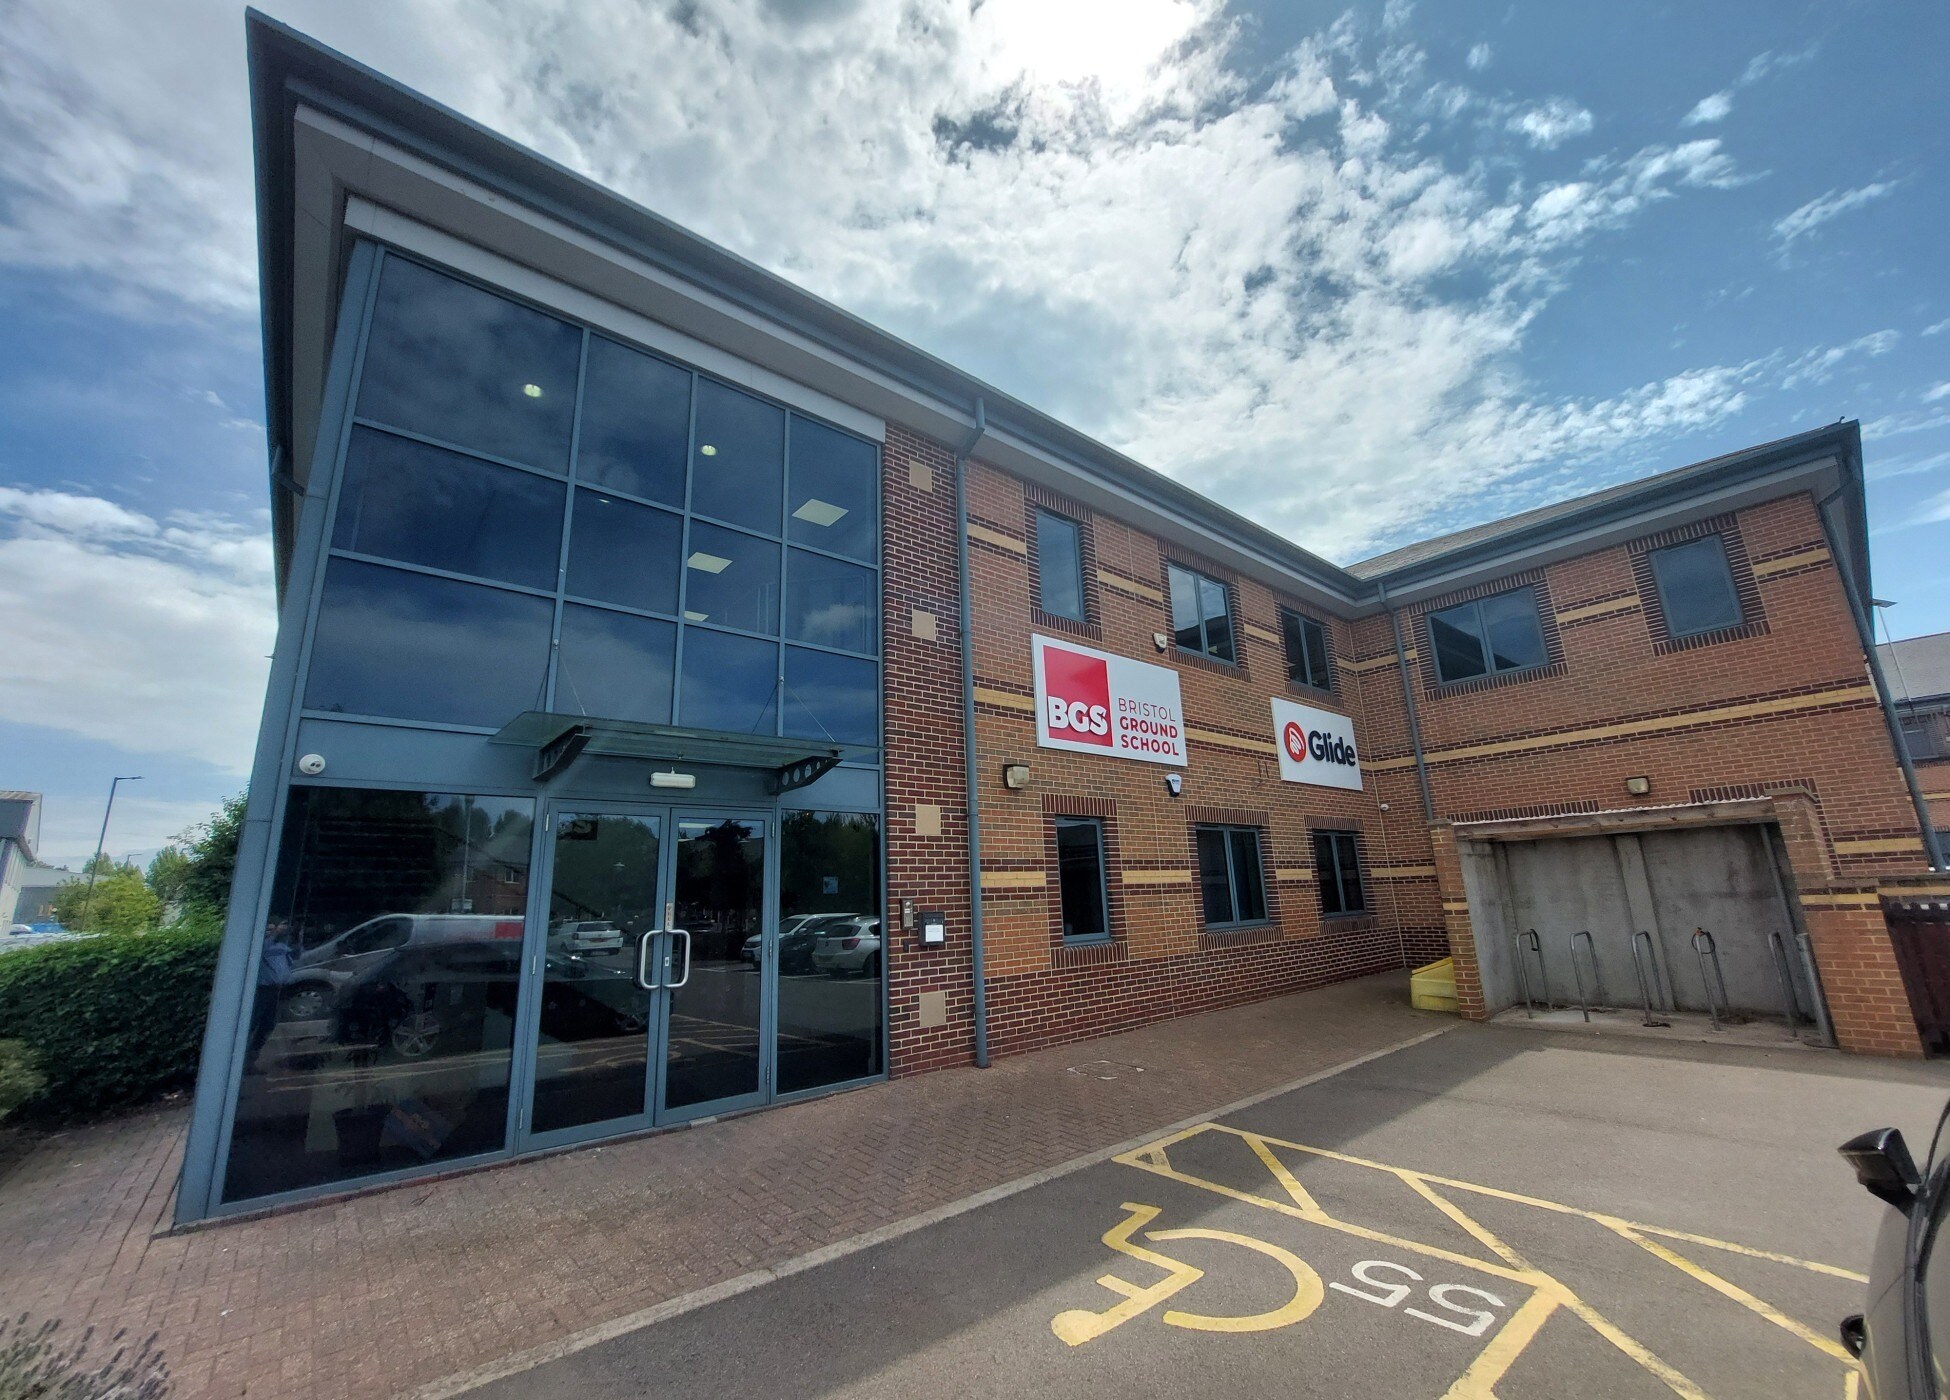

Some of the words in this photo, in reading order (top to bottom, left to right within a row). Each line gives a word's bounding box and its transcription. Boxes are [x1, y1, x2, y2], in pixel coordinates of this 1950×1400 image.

[1047, 696, 1108, 736] BGS
[1118, 698, 1176, 722] BRISTOL
[1119, 716, 1178, 738] GROUND
[1120, 734, 1179, 756] SCHOOL
[1308, 730, 1356, 767] Glide
[1329, 1260, 1505, 1336] 55
